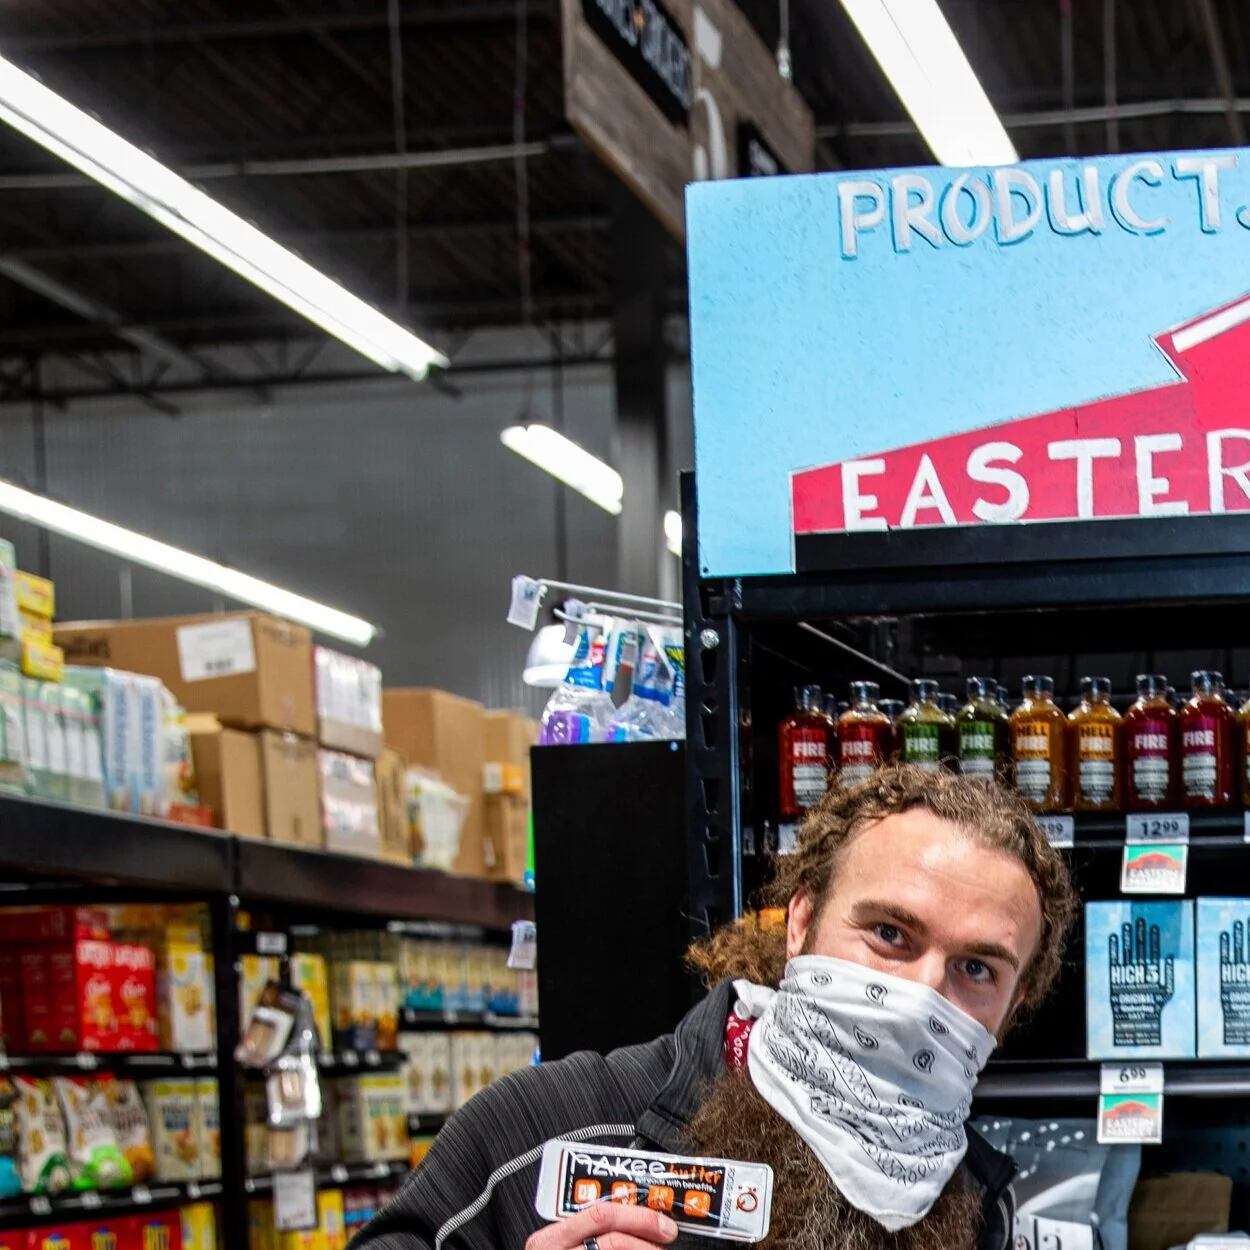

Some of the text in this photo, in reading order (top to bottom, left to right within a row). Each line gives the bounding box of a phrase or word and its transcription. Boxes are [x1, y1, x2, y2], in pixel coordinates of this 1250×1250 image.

[906, 738, 938, 752] FIRE
[960, 736, 993, 749] FIRE
[1016, 736, 1048, 750] FIRE
[1080, 737, 1112, 751] FIRE
[1134, 735, 1167, 749] FIRE
[793, 743, 826, 757] FIRE
[1111, 965, 1159, 983] HIGH 5
